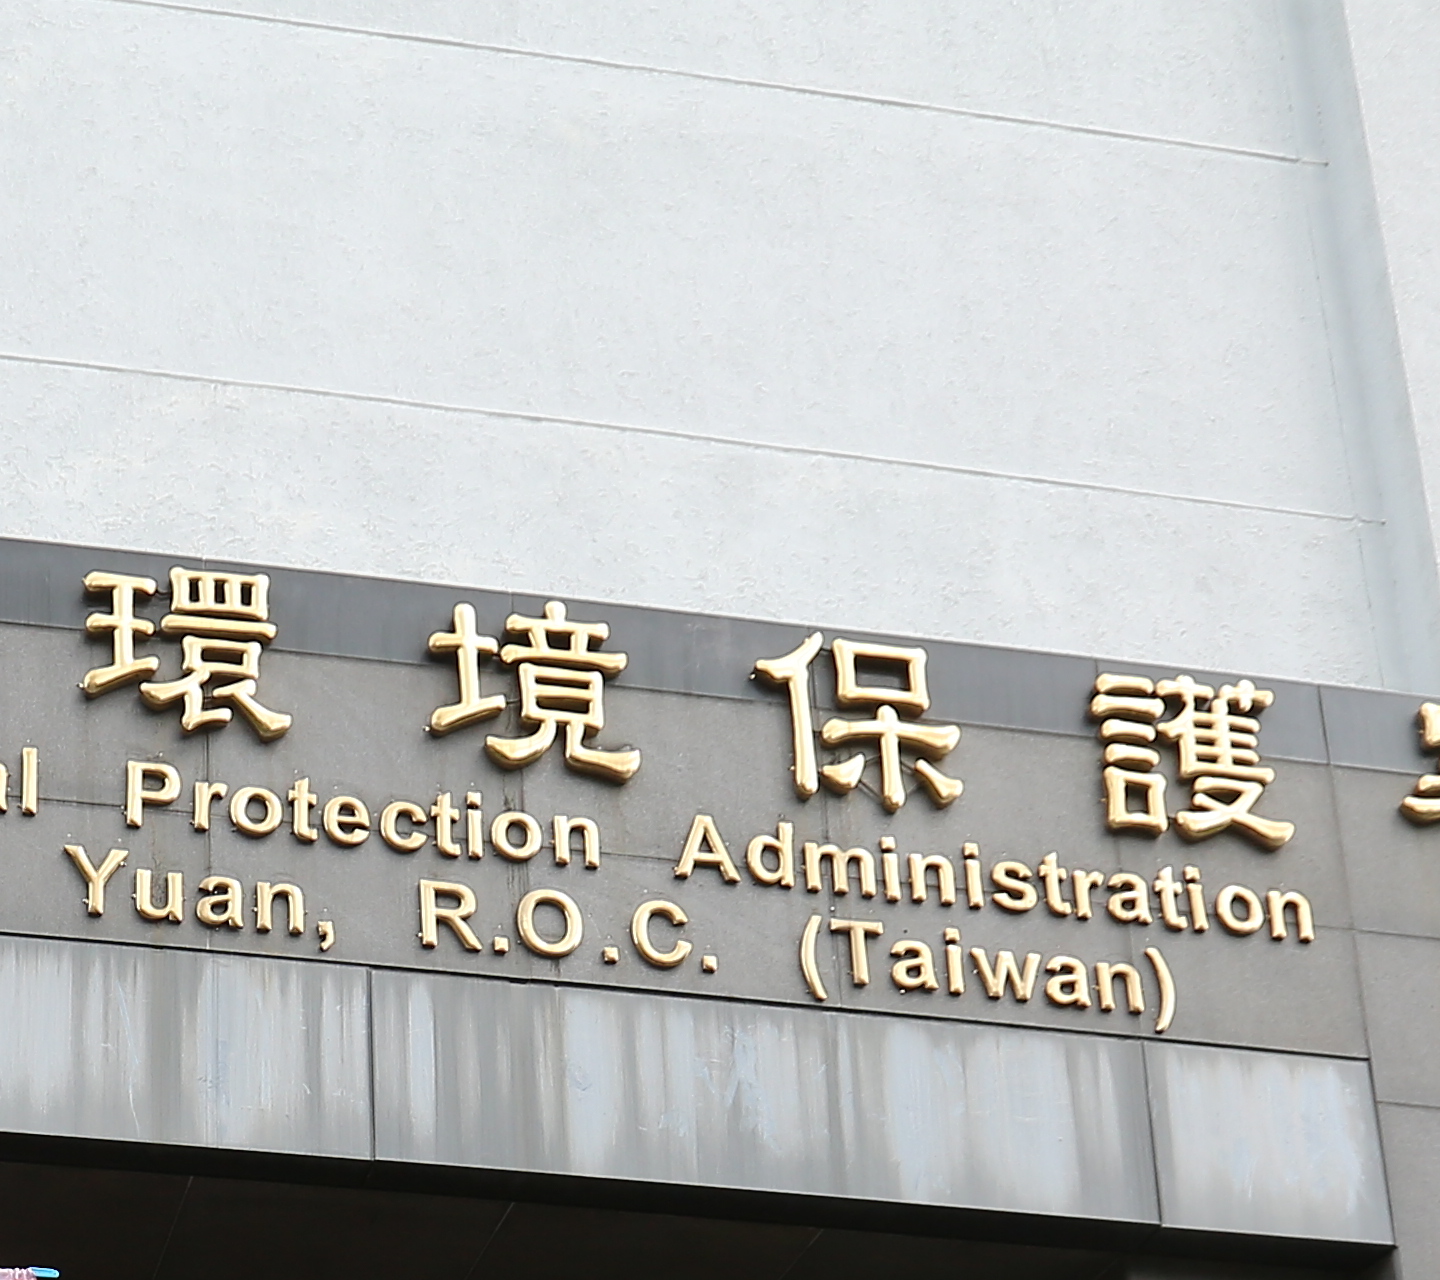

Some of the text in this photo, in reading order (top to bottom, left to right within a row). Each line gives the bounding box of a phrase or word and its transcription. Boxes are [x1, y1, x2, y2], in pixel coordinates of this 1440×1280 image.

[63, 843, 339, 952] Yuan,
[418, 878, 720, 975] R.O.C.
[796, 914, 1177, 1035] (Taiwan)
[123, 757, 603, 872] Protection
[671, 812, 1316, 944] Administration
